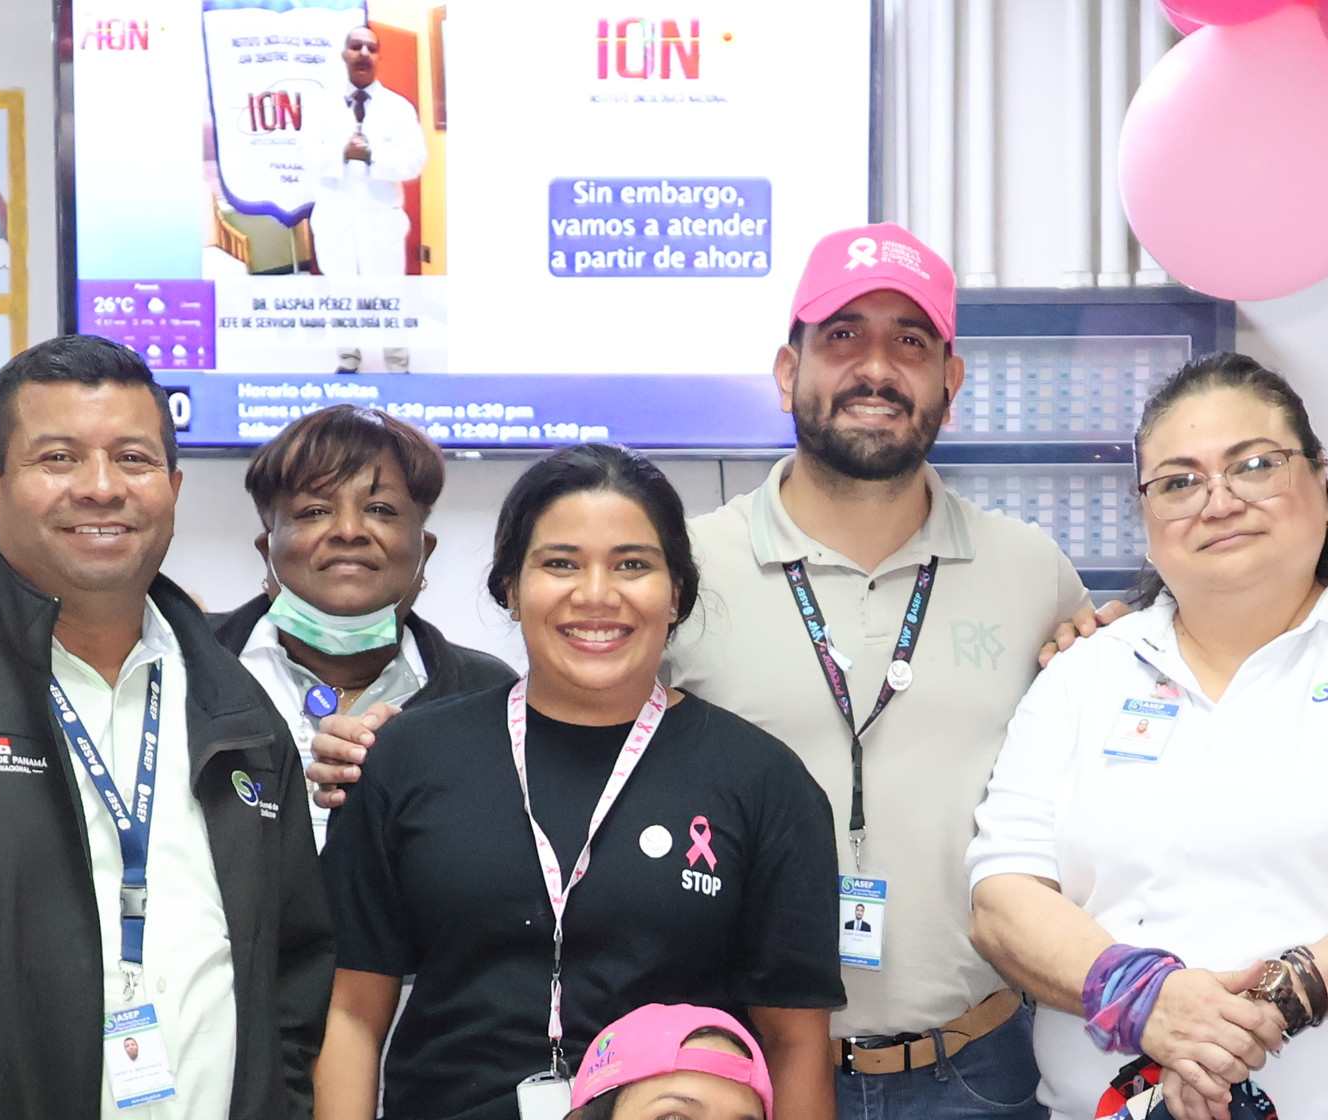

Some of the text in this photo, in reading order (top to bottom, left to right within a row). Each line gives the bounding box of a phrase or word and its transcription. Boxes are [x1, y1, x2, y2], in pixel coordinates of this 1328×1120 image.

[597, 17, 700, 79] ION
[248, 90, 302, 131] ION
[573, 180, 745, 209] Sin embargo,
[551, 213, 767, 237] vamos a atender
[551, 245, 768, 273] a partir de ahora
[93, 296, 135, 314] 26°C
[274, 298, 315, 311] GASPAR
[319, 295, 352, 311] PÉREZ
[238, 383, 379, 399] Horario de Visitas
[238, 403, 286, 418] Lunes
[289, 406, 301, 418] a
[425, 406, 453, 421] pm
[505, 406, 534, 421] pm
[500, 426, 528, 441] pm
[580, 426, 609, 441] pm
[50, 684, 73, 714] ASEP
[12, 756, 48, 768] PANAMÁ
[77, 736, 100, 768] ASEP
[144, 742, 156, 771] ASEP
[105, 790, 127, 820] ASEP
[137, 794, 149, 824] ASEP
[681, 868, 722, 897] STOP
[117, 1010, 141, 1022] ASEP
